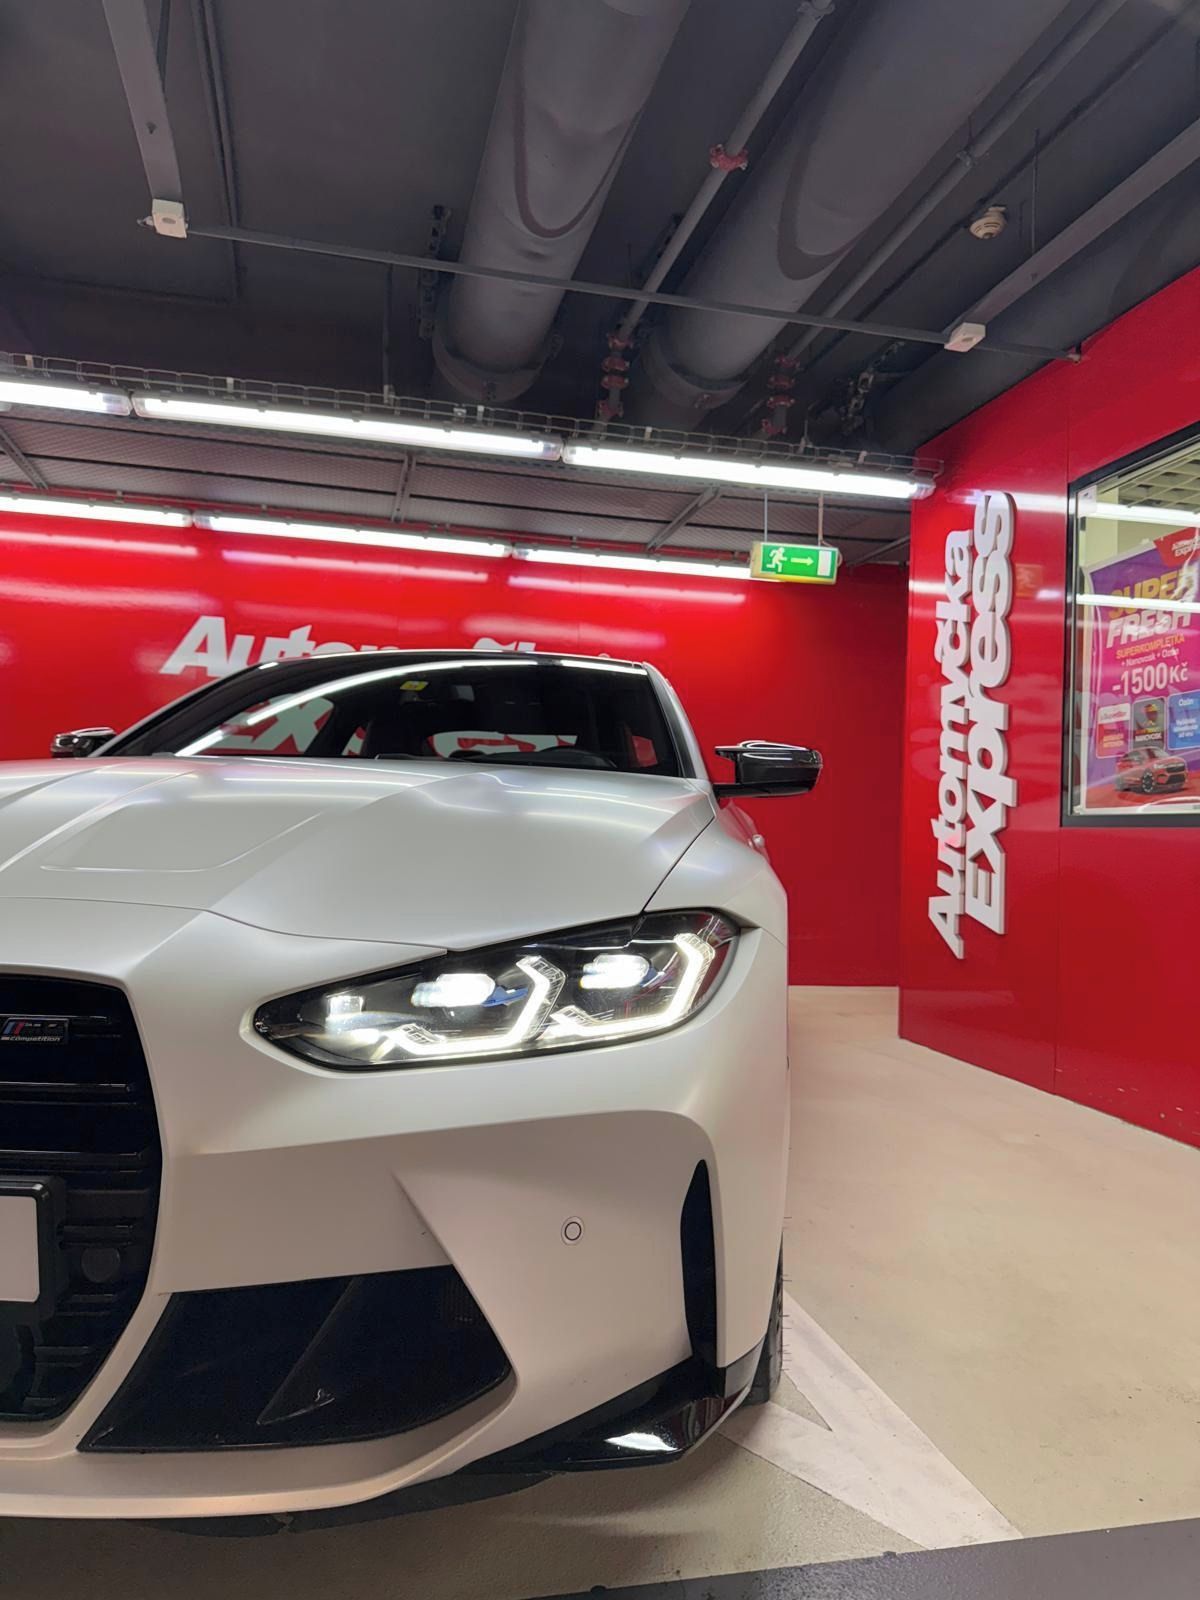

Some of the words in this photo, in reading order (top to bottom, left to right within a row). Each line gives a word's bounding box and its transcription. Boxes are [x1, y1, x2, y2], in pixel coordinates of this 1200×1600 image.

[1106, 607, 1191, 648] FRESH
[1112, 662, 1168, 696] -1500
[1170, 662, 1188, 684] Kč
[965, 490, 1017, 935] Express
